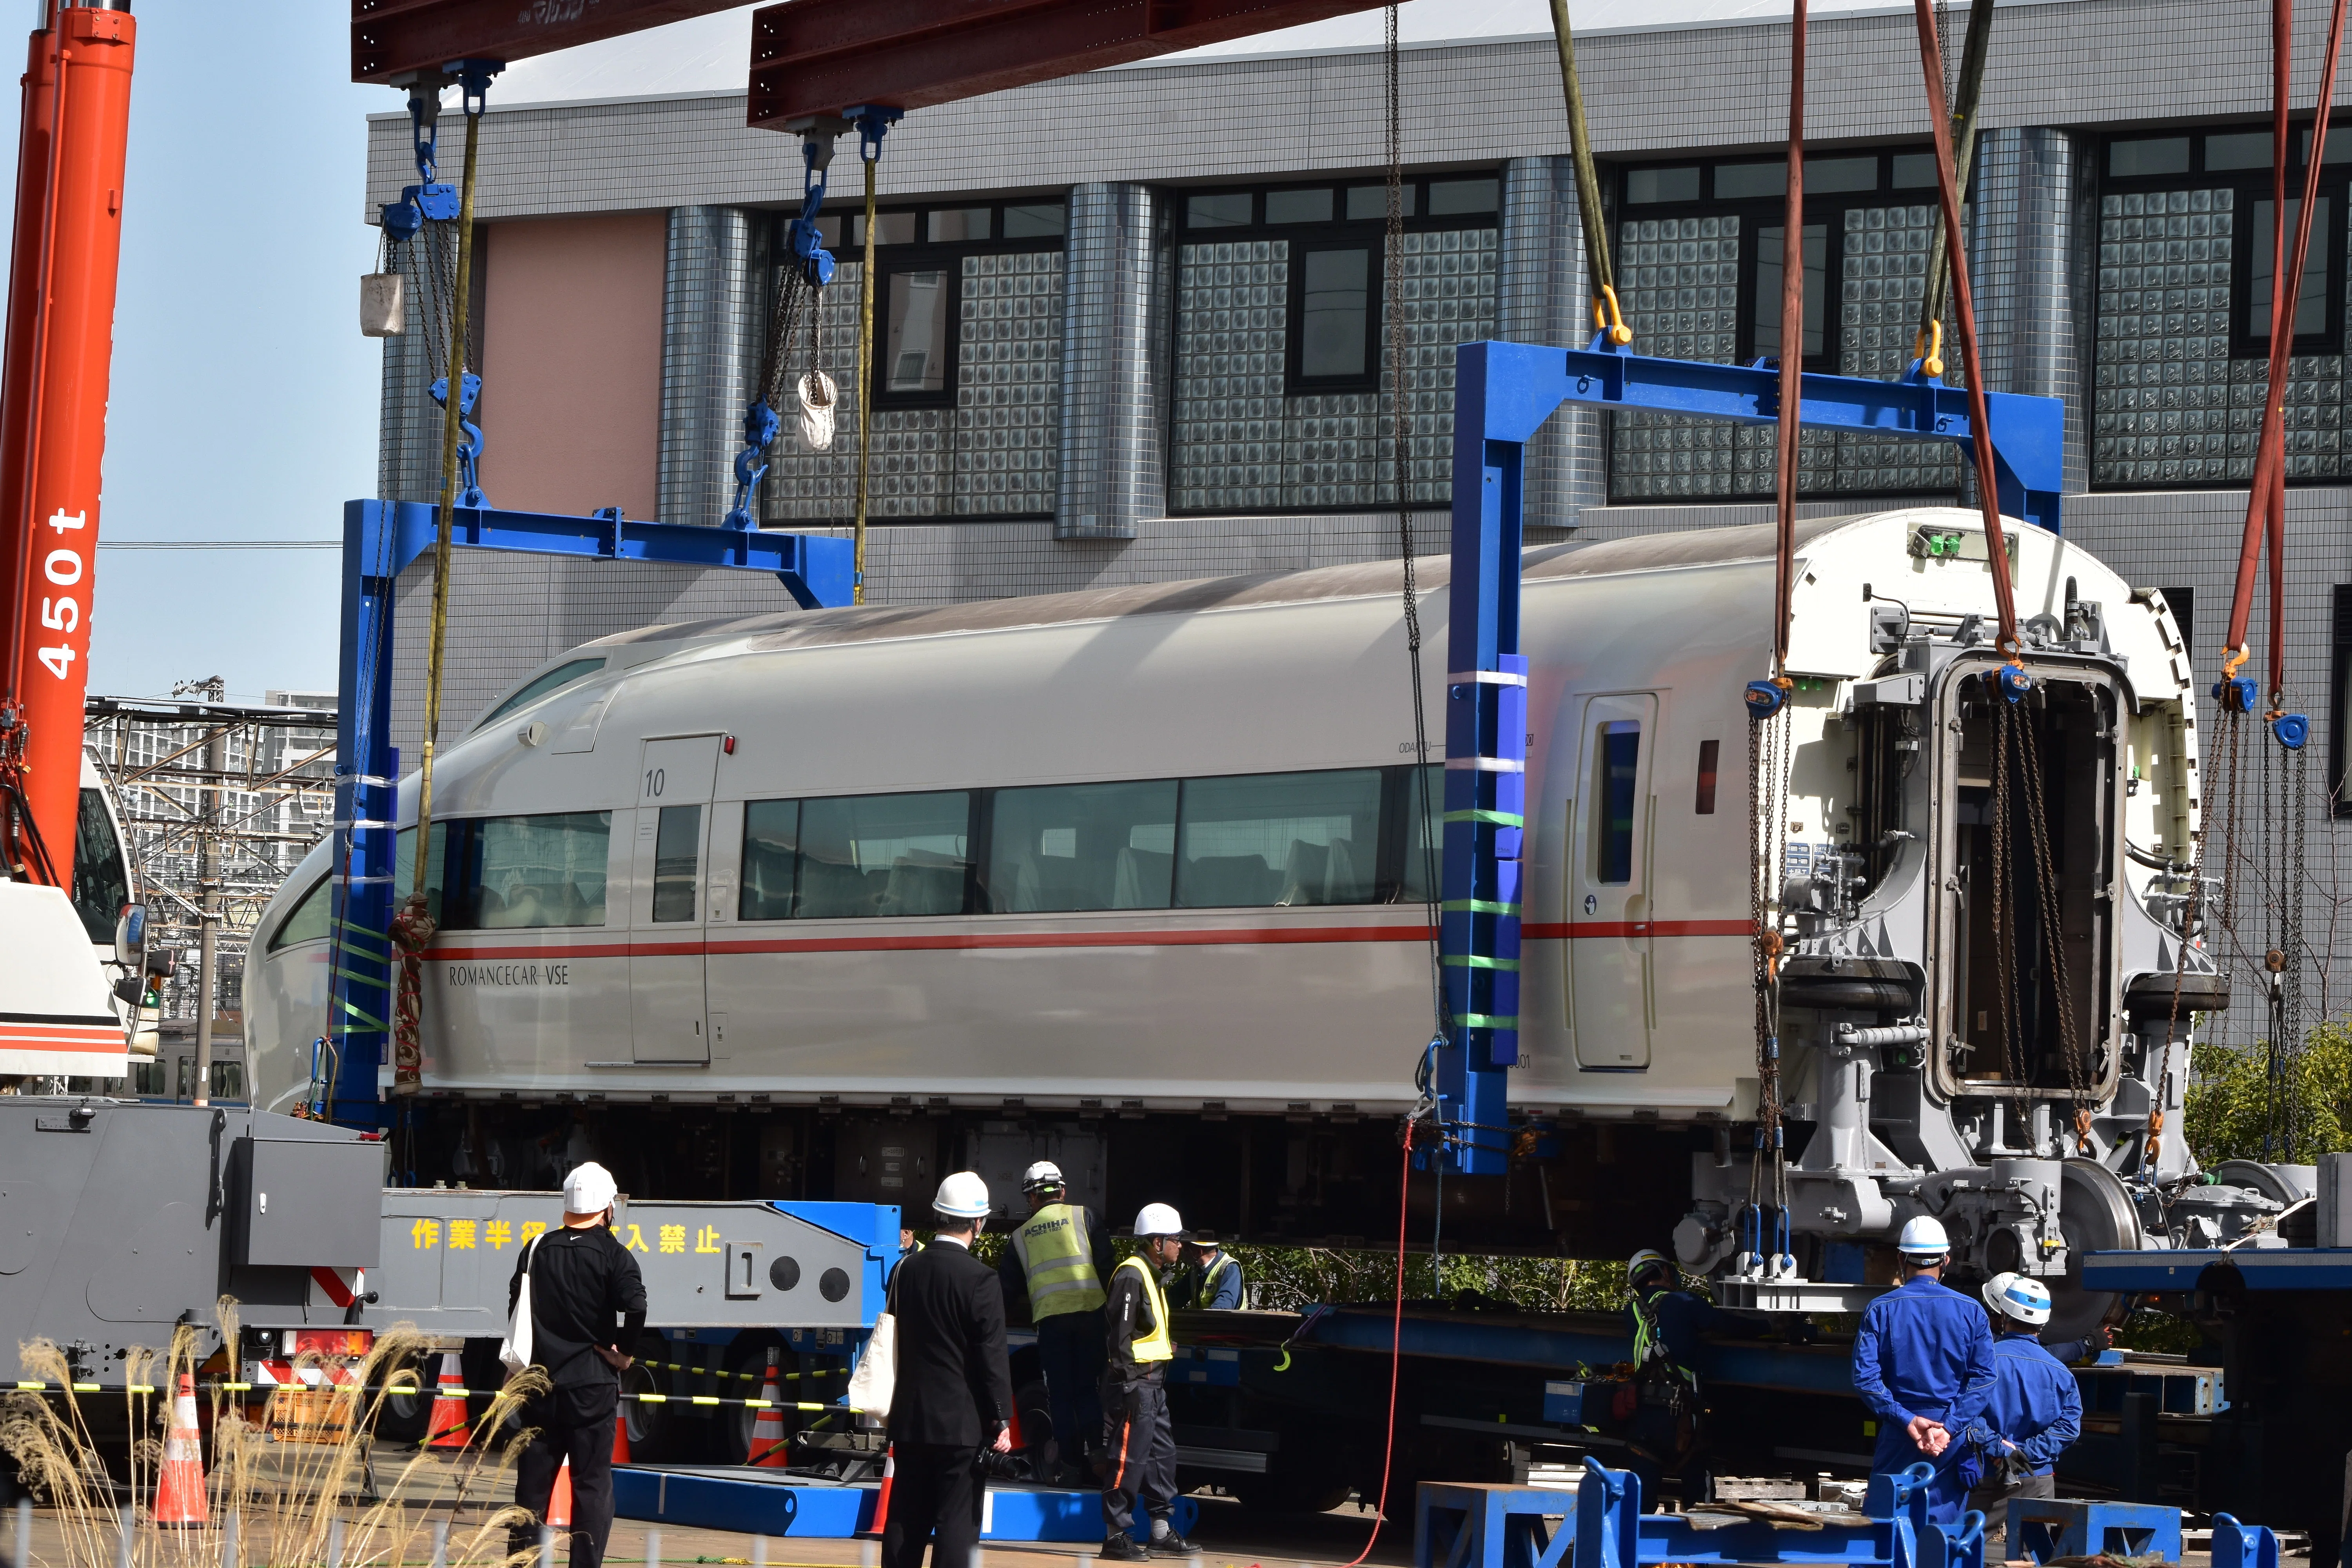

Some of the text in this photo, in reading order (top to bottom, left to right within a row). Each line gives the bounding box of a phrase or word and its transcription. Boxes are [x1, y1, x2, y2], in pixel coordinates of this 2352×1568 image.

[1399, 741, 1431, 753] ODAU
[646, 768, 665, 797] 10
[1025, 1218, 1069, 1237] ACHIHA
[1031, 1229, 1047, 1238] SINCE
